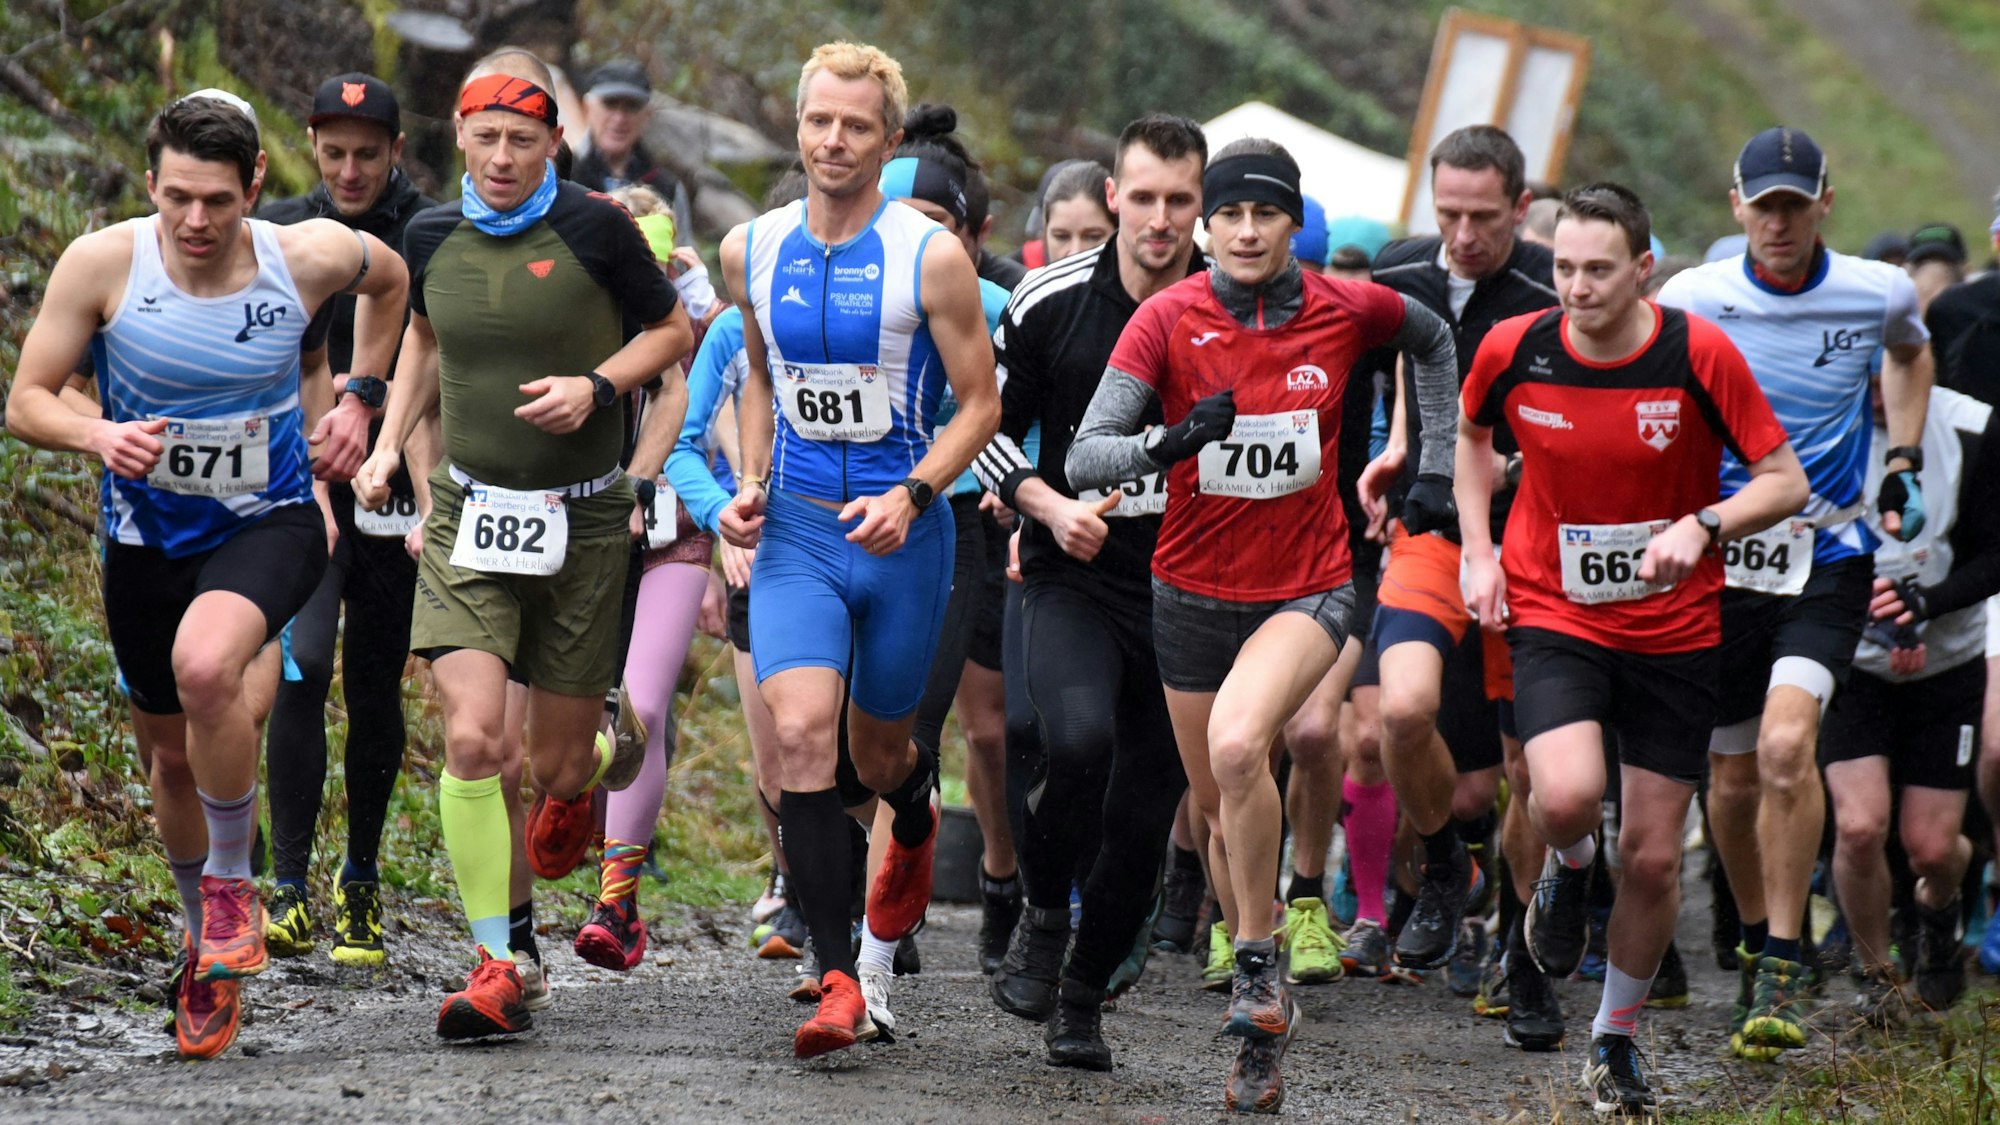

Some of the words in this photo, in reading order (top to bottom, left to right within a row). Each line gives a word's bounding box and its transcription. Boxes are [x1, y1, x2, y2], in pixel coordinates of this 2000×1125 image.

[782, 262, 816, 276] shark
[834, 265, 865, 277] bronny
[830, 292, 847, 301] PSV
[848, 293, 873, 302] BONN
[834, 300, 873, 308] TRIATHLON
[804, 366, 844, 376] Volksbank
[805, 376, 844, 387] Oberberg
[845, 376, 857, 385] eG
[1286, 371, 1315, 386] LAZ
[797, 387, 864, 425] 681
[186, 422, 229, 432] Volksbank
[1234, 419, 1277, 429] Volksbank
[184, 432, 228, 442] Oberberg
[830, 427, 841, 439] &
[1233, 429, 1276, 439] Oberberg
[1277, 428, 1290, 437] eG
[168, 444, 242, 479] 671
[1220, 441, 1299, 479] 704
[203, 484, 214, 494] &
[1206, 480, 1252, 494] CRAMER
[1255, 482, 1266, 494] &
[488, 491, 529, 501] Volksbank
[488, 500, 527, 512] Oberberg
[528, 503, 540, 512] eG
[361, 520, 400, 531] CRAMER
[474, 513, 546, 554] 682
[501, 556, 512, 568] &
[1723, 538, 1790, 575] 664
[1617, 586, 1627, 598] &
